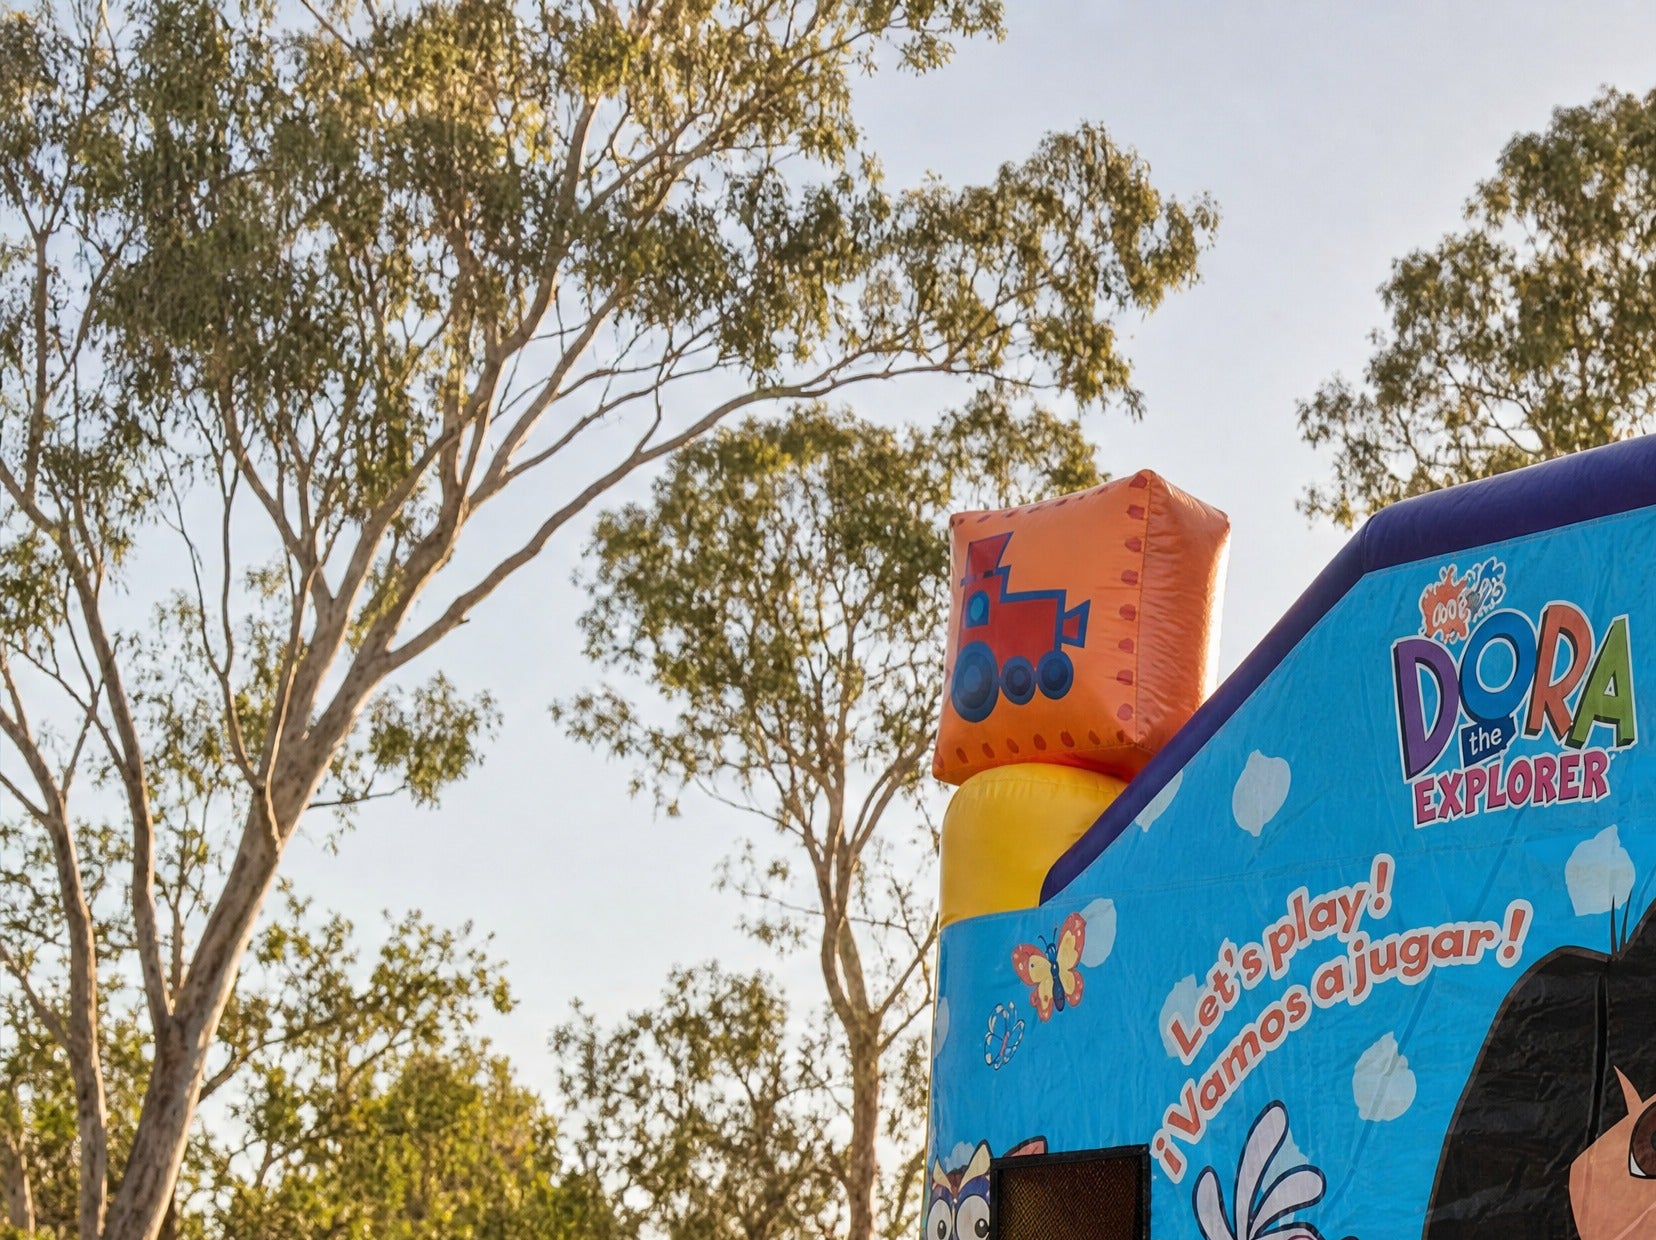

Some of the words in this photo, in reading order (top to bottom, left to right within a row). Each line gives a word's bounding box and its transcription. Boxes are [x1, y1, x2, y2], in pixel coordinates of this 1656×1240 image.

[1393, 602, 1637, 780] DORA
[1468, 726, 1503, 755] the
[1413, 750, 1609, 825] EXPLORER
[1155, 991, 1307, 1175] ¡Vamos
[1316, 964, 1344, 1000] a
[1351, 908, 1526, 997] jugar!
[1170, 948, 1263, 1058] Let's
[1268, 861, 1389, 972] play!
